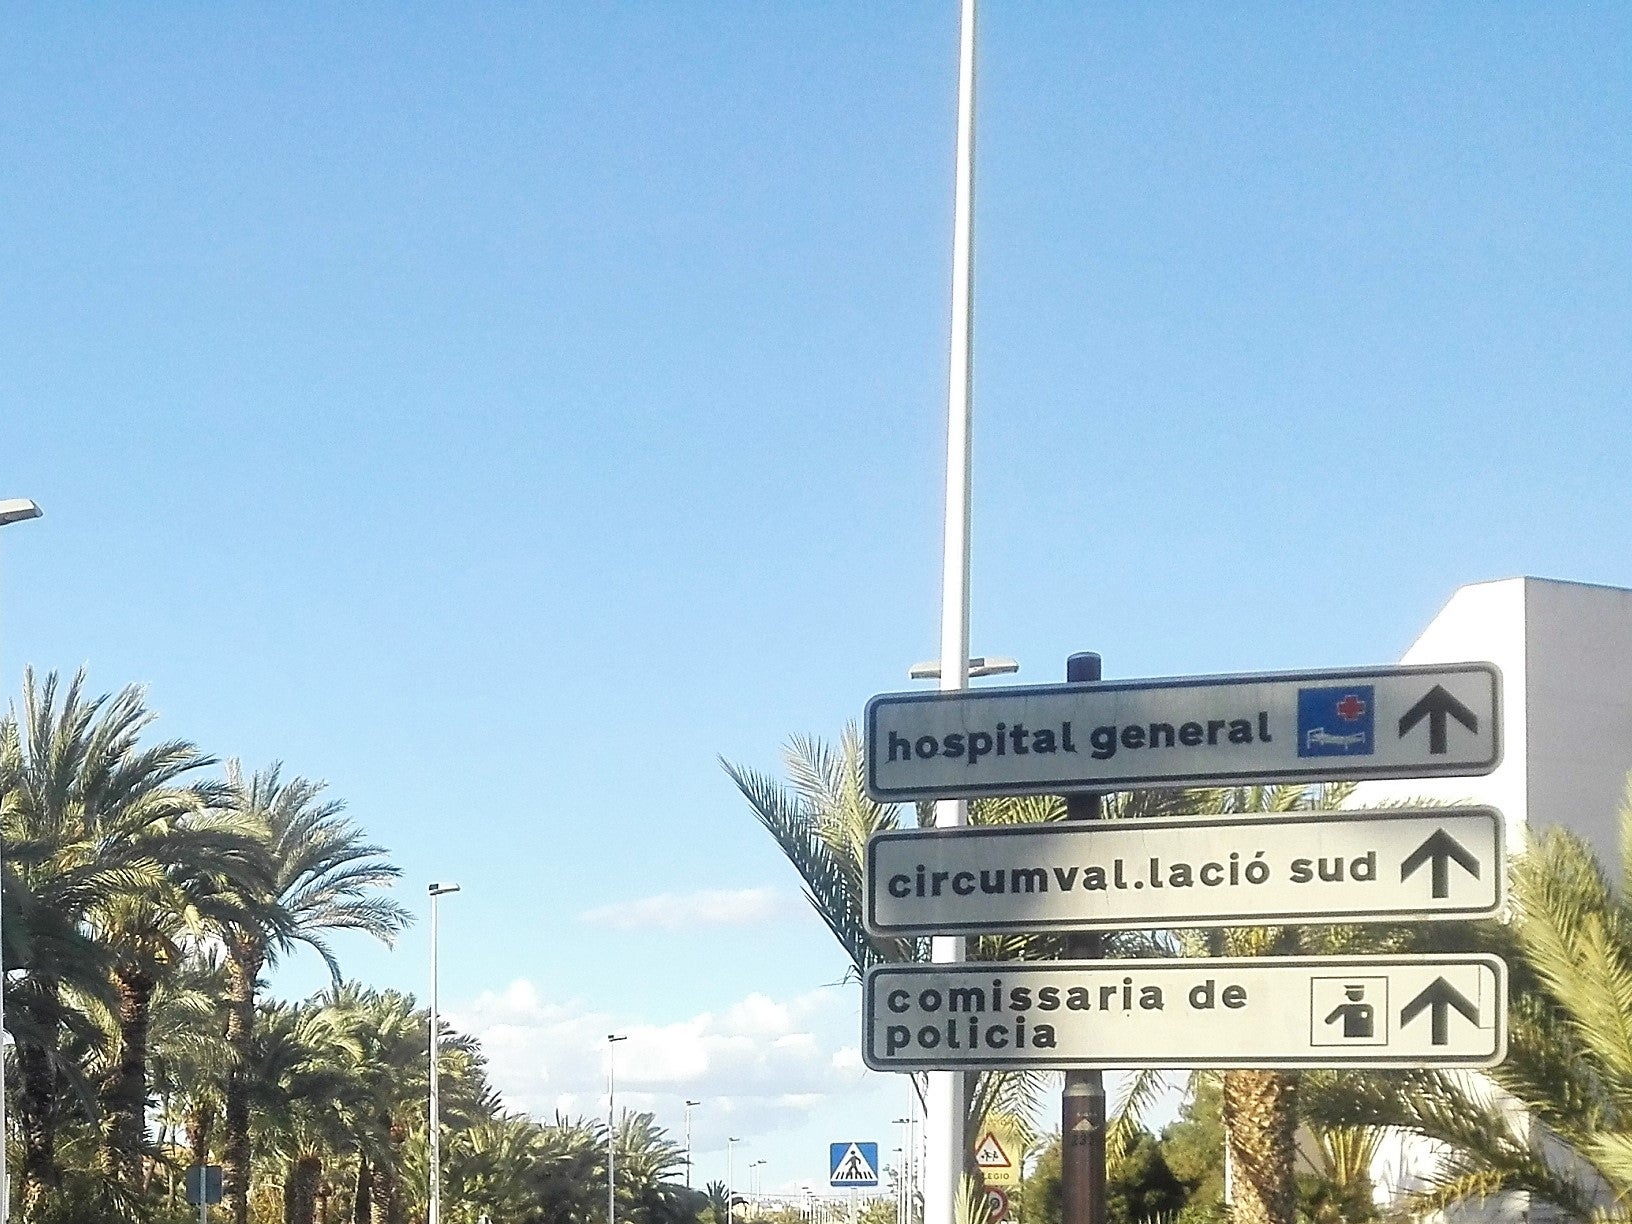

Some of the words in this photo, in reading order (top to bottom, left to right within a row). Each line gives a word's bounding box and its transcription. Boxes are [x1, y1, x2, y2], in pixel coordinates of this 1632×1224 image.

[887, 721, 1077, 765] hospital
[1089, 711, 1272, 760] general
[887, 851, 1270, 898] circumval.lació
[1289, 851, 1377, 883] sud
[886, 978, 1165, 1013] comissaria
[1188, 980, 1247, 1010] de
[886, 1015, 1057, 1056] policia
